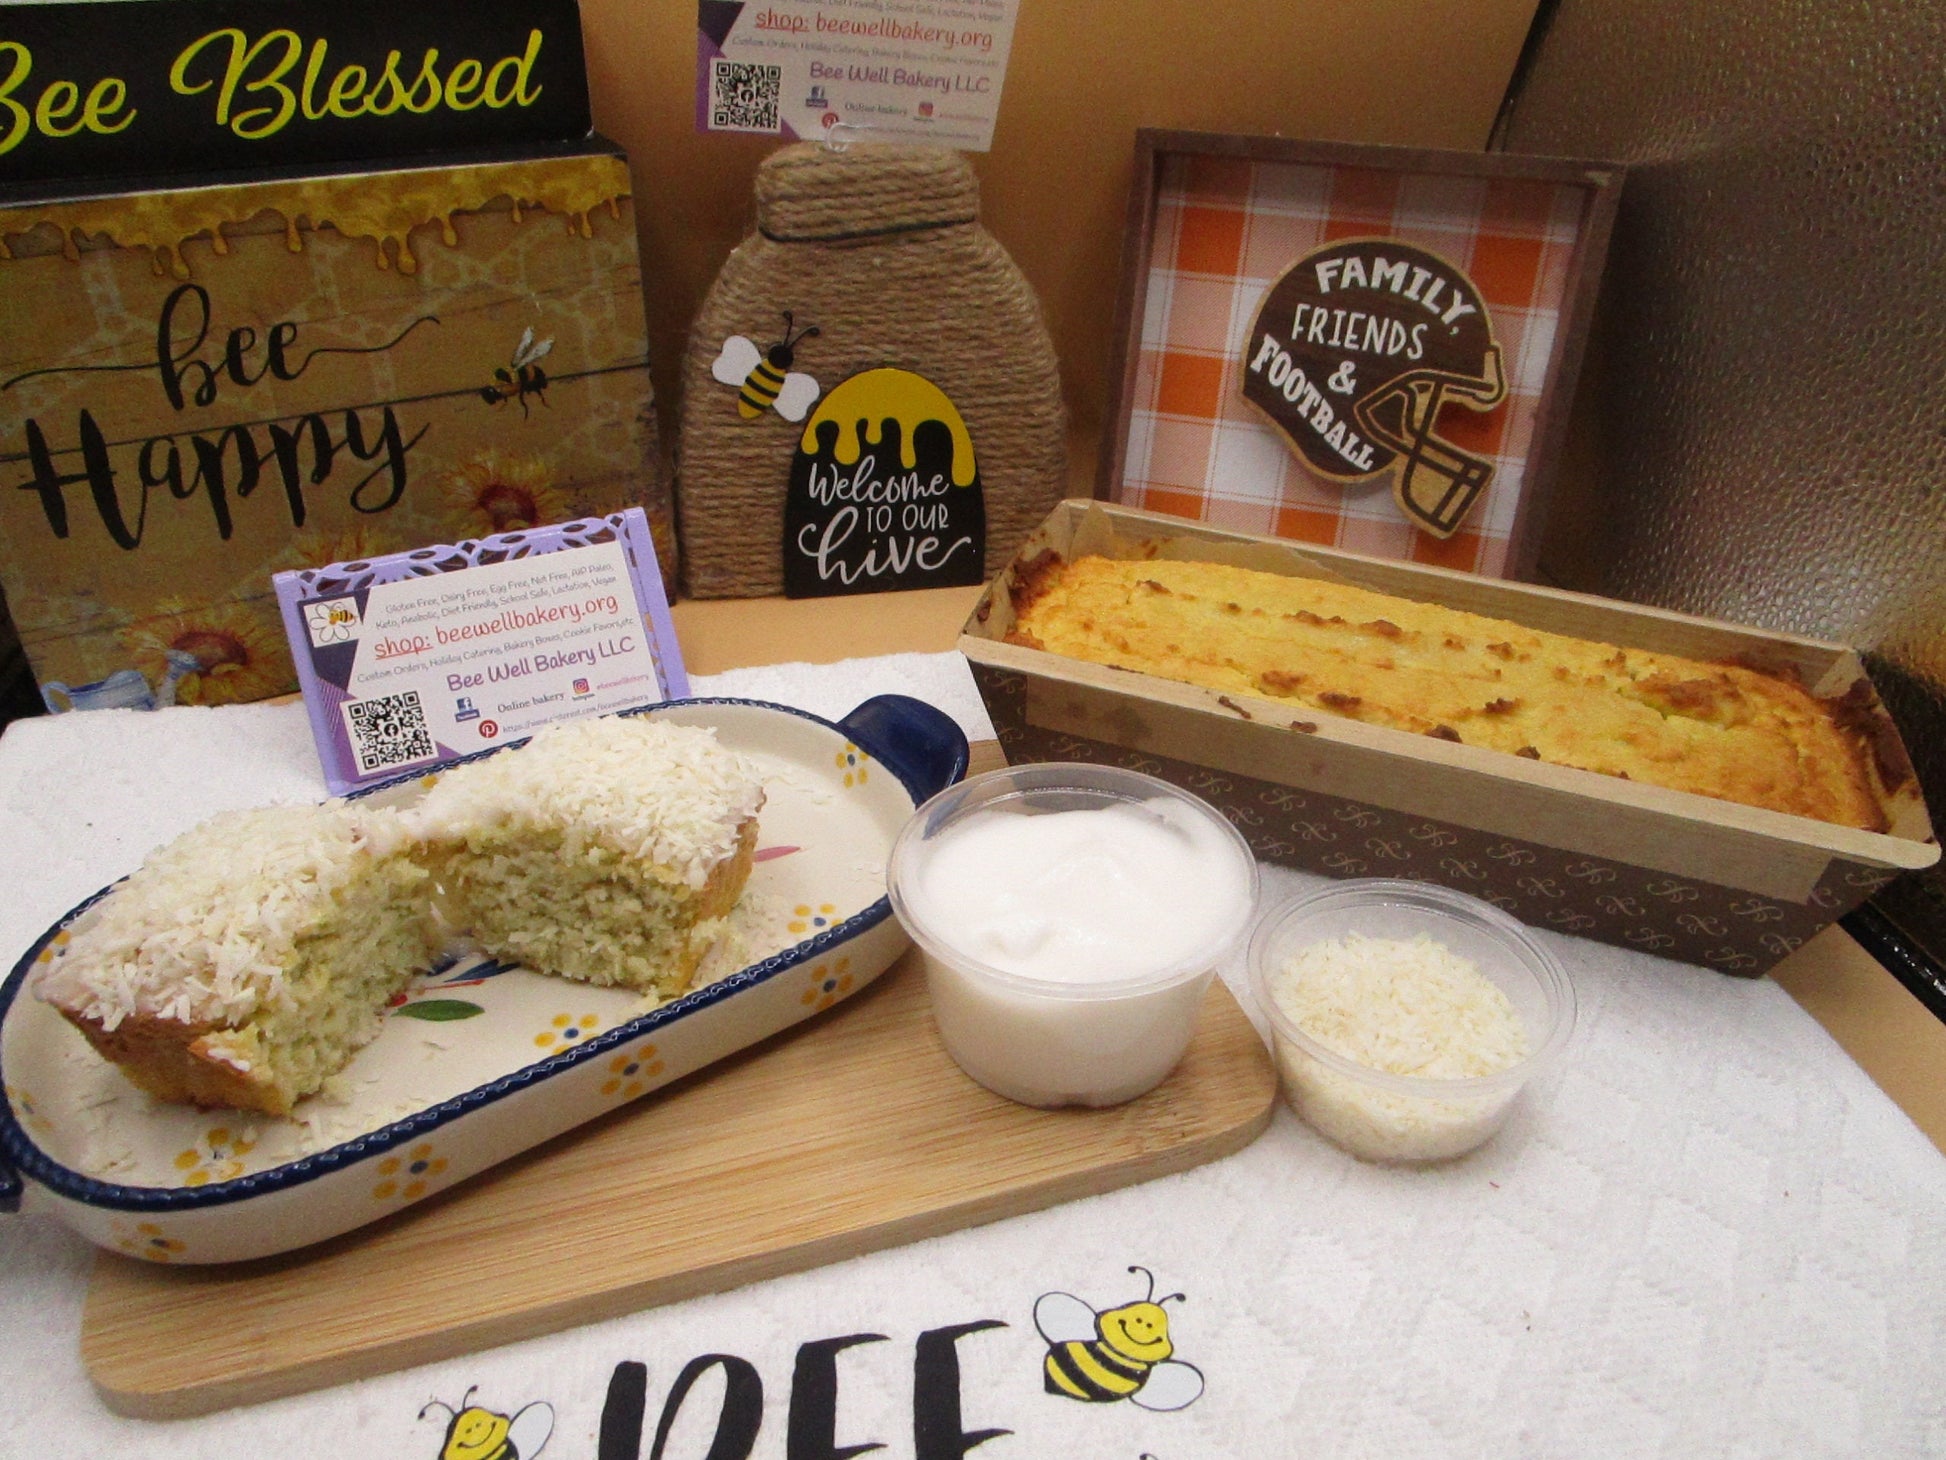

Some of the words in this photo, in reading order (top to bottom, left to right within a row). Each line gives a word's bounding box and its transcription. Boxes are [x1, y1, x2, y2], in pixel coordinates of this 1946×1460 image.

[755, 8, 810, 34] shop:
[816, 11, 993, 52] beewellbakery.org
[169, 28, 543, 139] Blessed
[810, 61, 844, 79] Bee
[848, 65, 889, 85] Well
[893, 68, 950, 94] Bakery
[955, 75, 991, 94] LLC
[1291, 303, 1428, 360] FRIENDS
[1250, 333, 1374, 471] FOOTBALL
[1328, 360, 1356, 395] &
[8, 406, 431, 551] Happy
[808, 455, 950, 506] Welcome
[866, 505, 892, 533] TO
[902, 503, 949, 531] OUR
[798, 506, 972, 585] hive
[441, 593, 465, 603] Dairy
[374, 636, 434, 660] shop:
[435, 595, 619, 645] beewellbakery.org
[446, 672, 485, 692] Bee
[488, 657, 532, 682] Well
[534, 647, 597, 672] Bakery
[598, 636, 635, 658] LLC
[497, 699, 530, 713] Online
[531, 692, 565, 706] bakery
